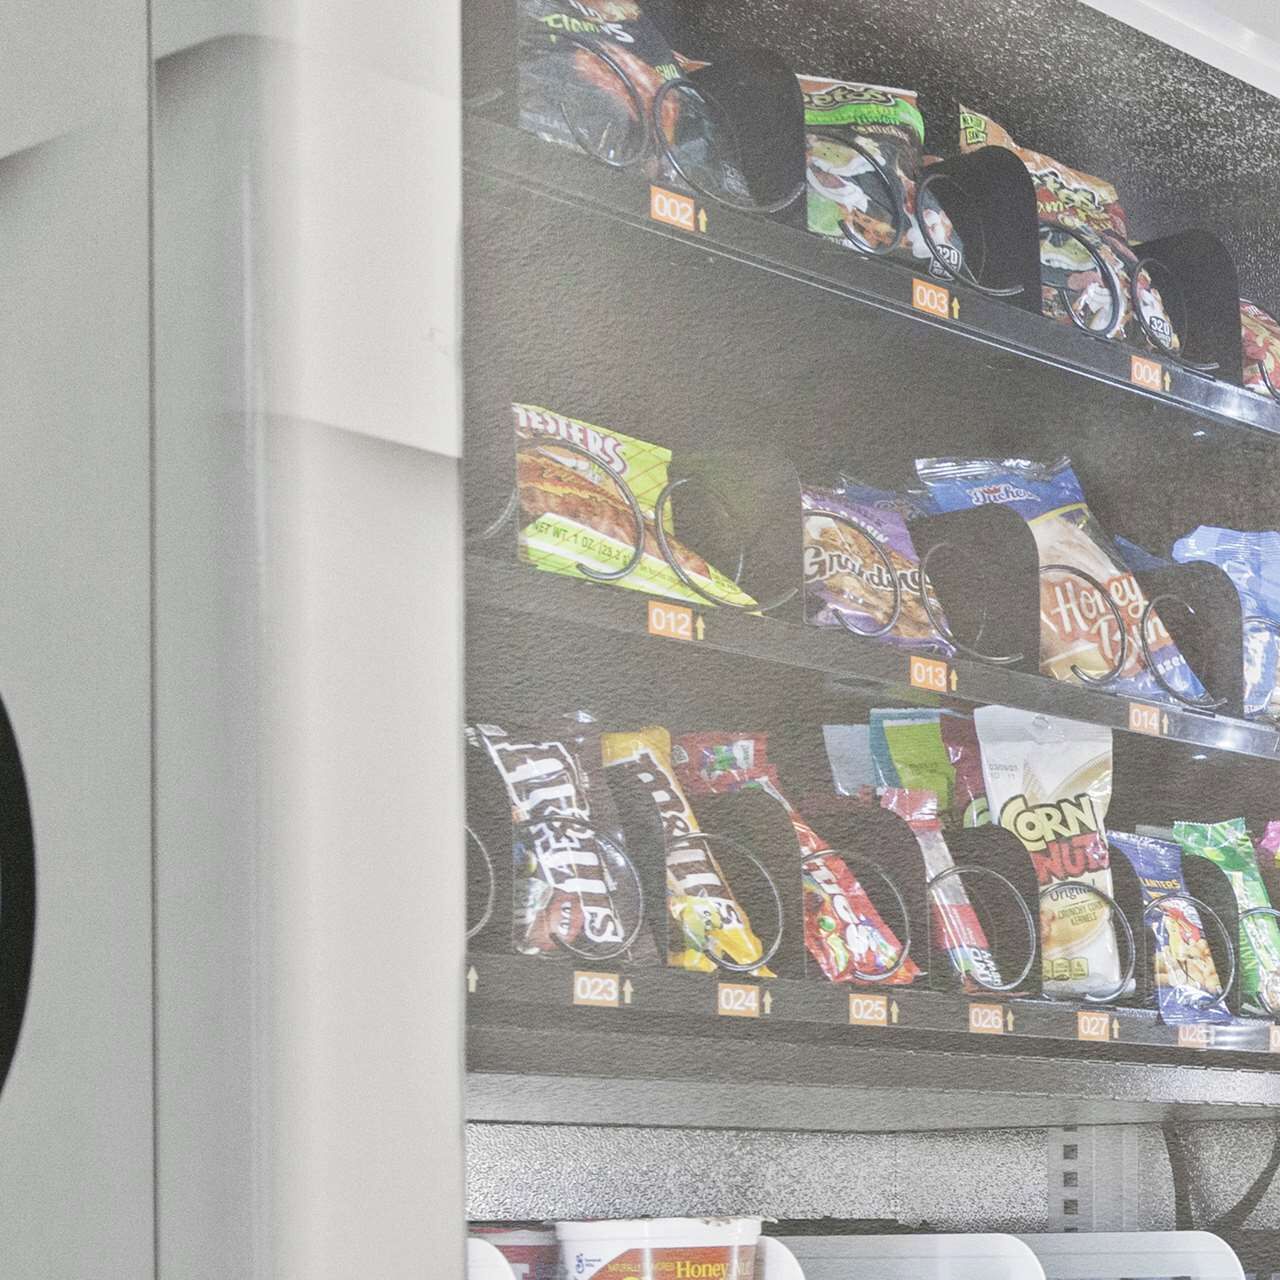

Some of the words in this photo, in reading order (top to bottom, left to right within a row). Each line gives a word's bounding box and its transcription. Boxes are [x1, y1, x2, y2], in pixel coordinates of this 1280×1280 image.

[655, 192, 693, 225] 002
[916, 284, 949, 314] 003
[1133, 361, 1161, 387] 004
[1052, 574, 1150, 633] Honey
[652, 606, 692, 635] 012
[913, 662, 947, 688] 013
[1131, 705, 1160, 730] 014
[1001, 794, 1098, 851] CORN
[1141, 876, 1181, 891] LANTERS
[577, 974, 619, 1002] 023
[720, 986, 759, 1013] 024
[851, 998, 887, 1023] 025
[970, 1007, 1002, 1030] 026
[1079, 1013, 1109, 1036] 027
